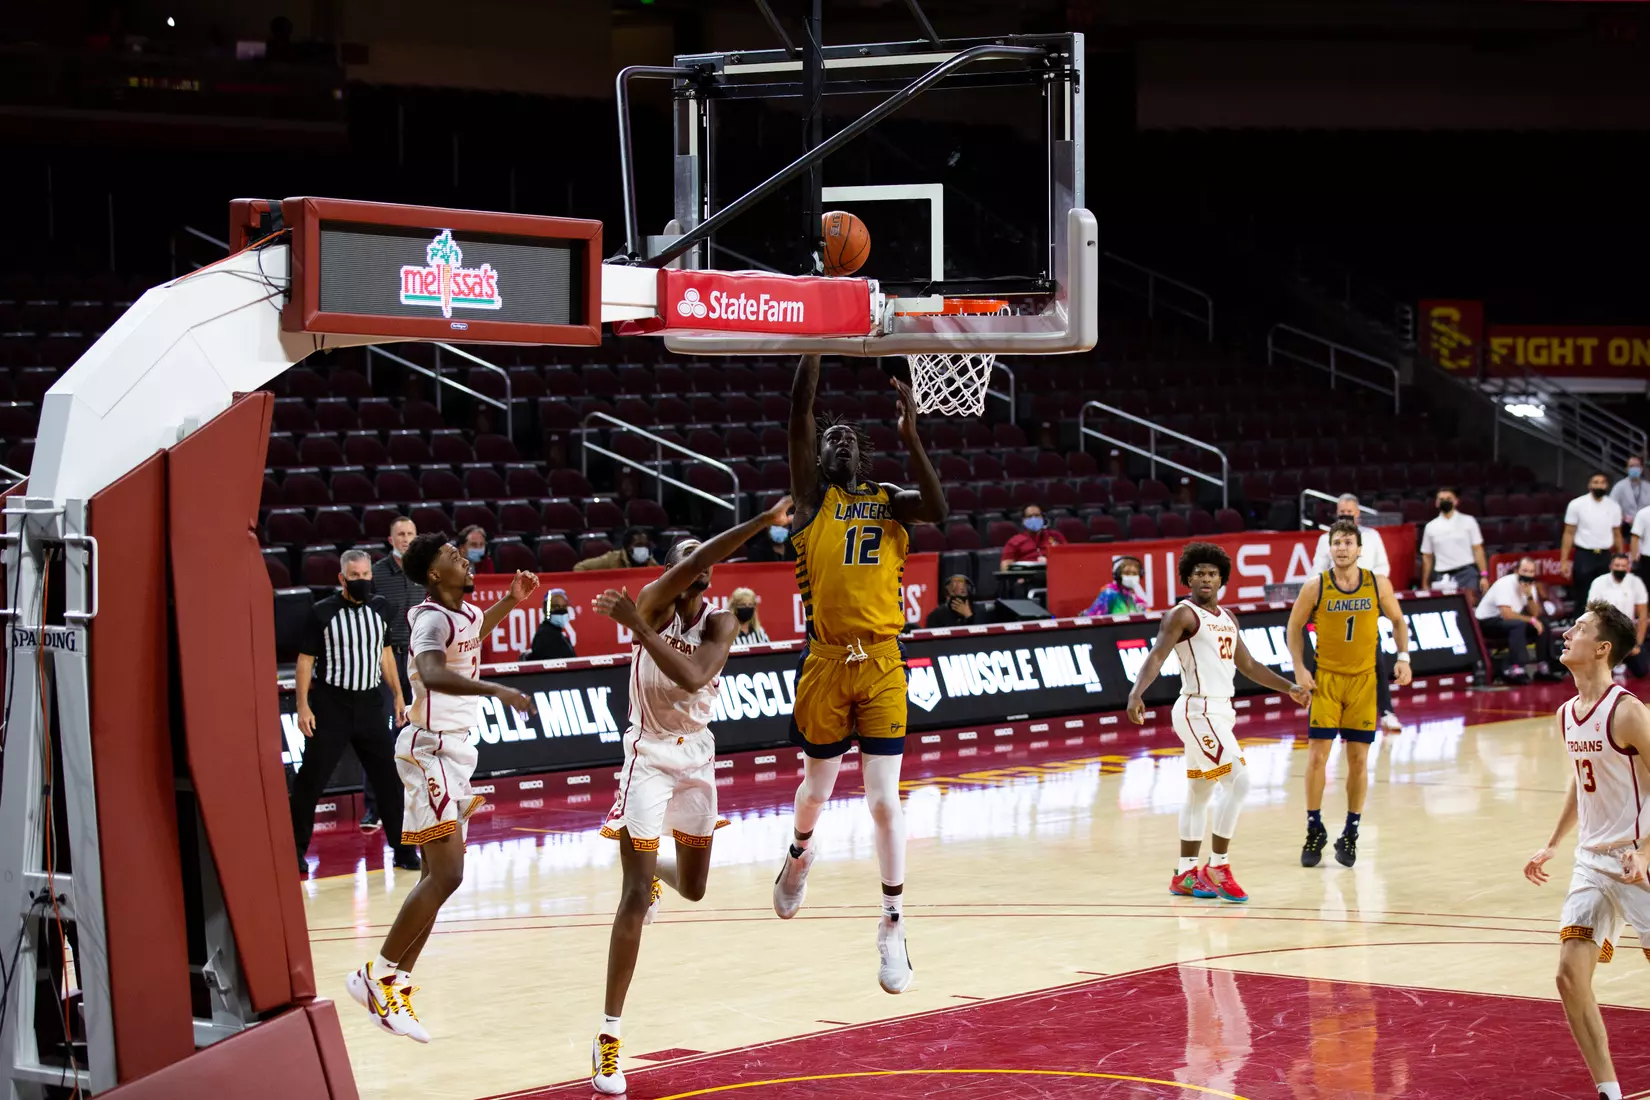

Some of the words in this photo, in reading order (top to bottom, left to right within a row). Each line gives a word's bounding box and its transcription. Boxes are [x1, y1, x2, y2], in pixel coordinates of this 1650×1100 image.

[1490, 336, 1599, 367] FIGHT
[842, 525, 884, 566] 12
[1327, 597, 1373, 612] LANCERS
[1344, 615, 1356, 642] 1
[937, 649, 1040, 698] MUSCLE
[533, 686, 618, 738] MILK
[1567, 740, 1603, 753] TROJANS
